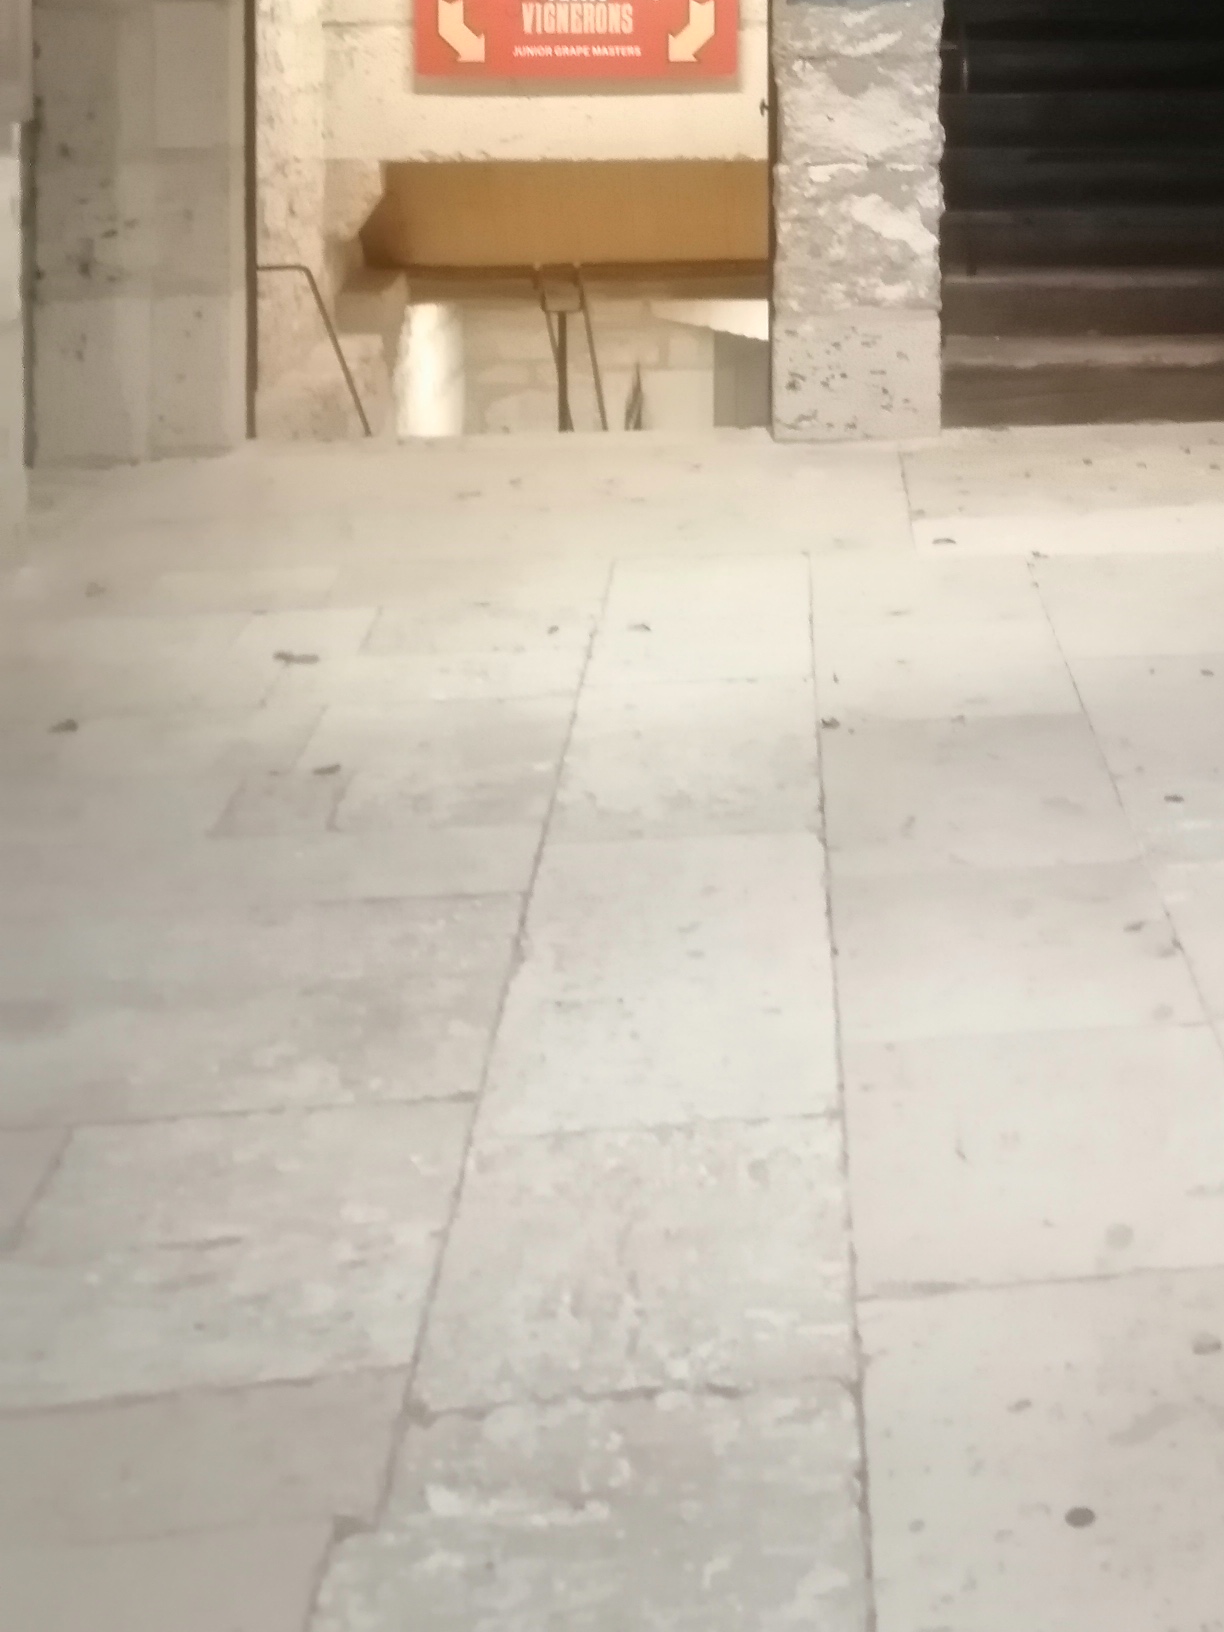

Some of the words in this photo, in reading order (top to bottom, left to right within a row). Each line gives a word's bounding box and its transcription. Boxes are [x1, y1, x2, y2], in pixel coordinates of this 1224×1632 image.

[521, 2, 633, 34] VIGNERONS
[512, 44, 553, 57] JUNIOR
[553, 44, 591, 57] GRAPE
[591, 44, 642, 57] MASTERS
